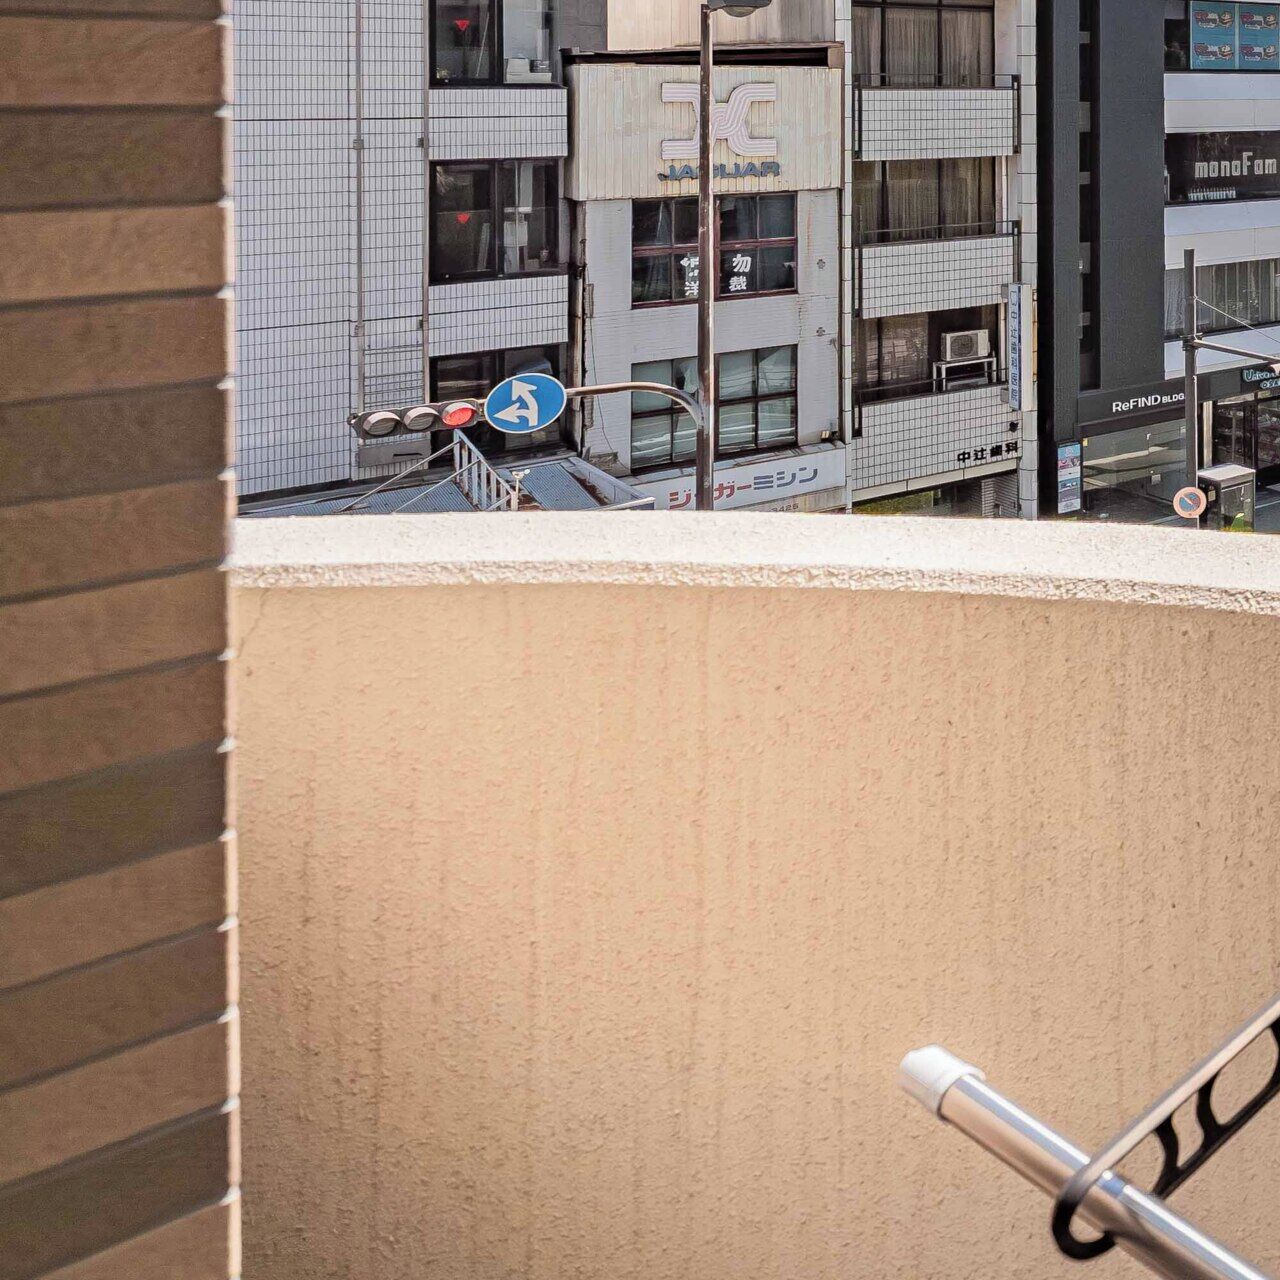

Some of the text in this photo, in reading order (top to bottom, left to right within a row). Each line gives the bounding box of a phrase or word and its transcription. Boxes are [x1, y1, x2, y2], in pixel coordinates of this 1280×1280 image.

[1195, 152, 1278, 178] monoFam
[1112, 394, 1161, 413] ReFIND
[956, 440, 1018, 464] 中辻歯科
[668, 466, 818, 510] ジガーミシン
